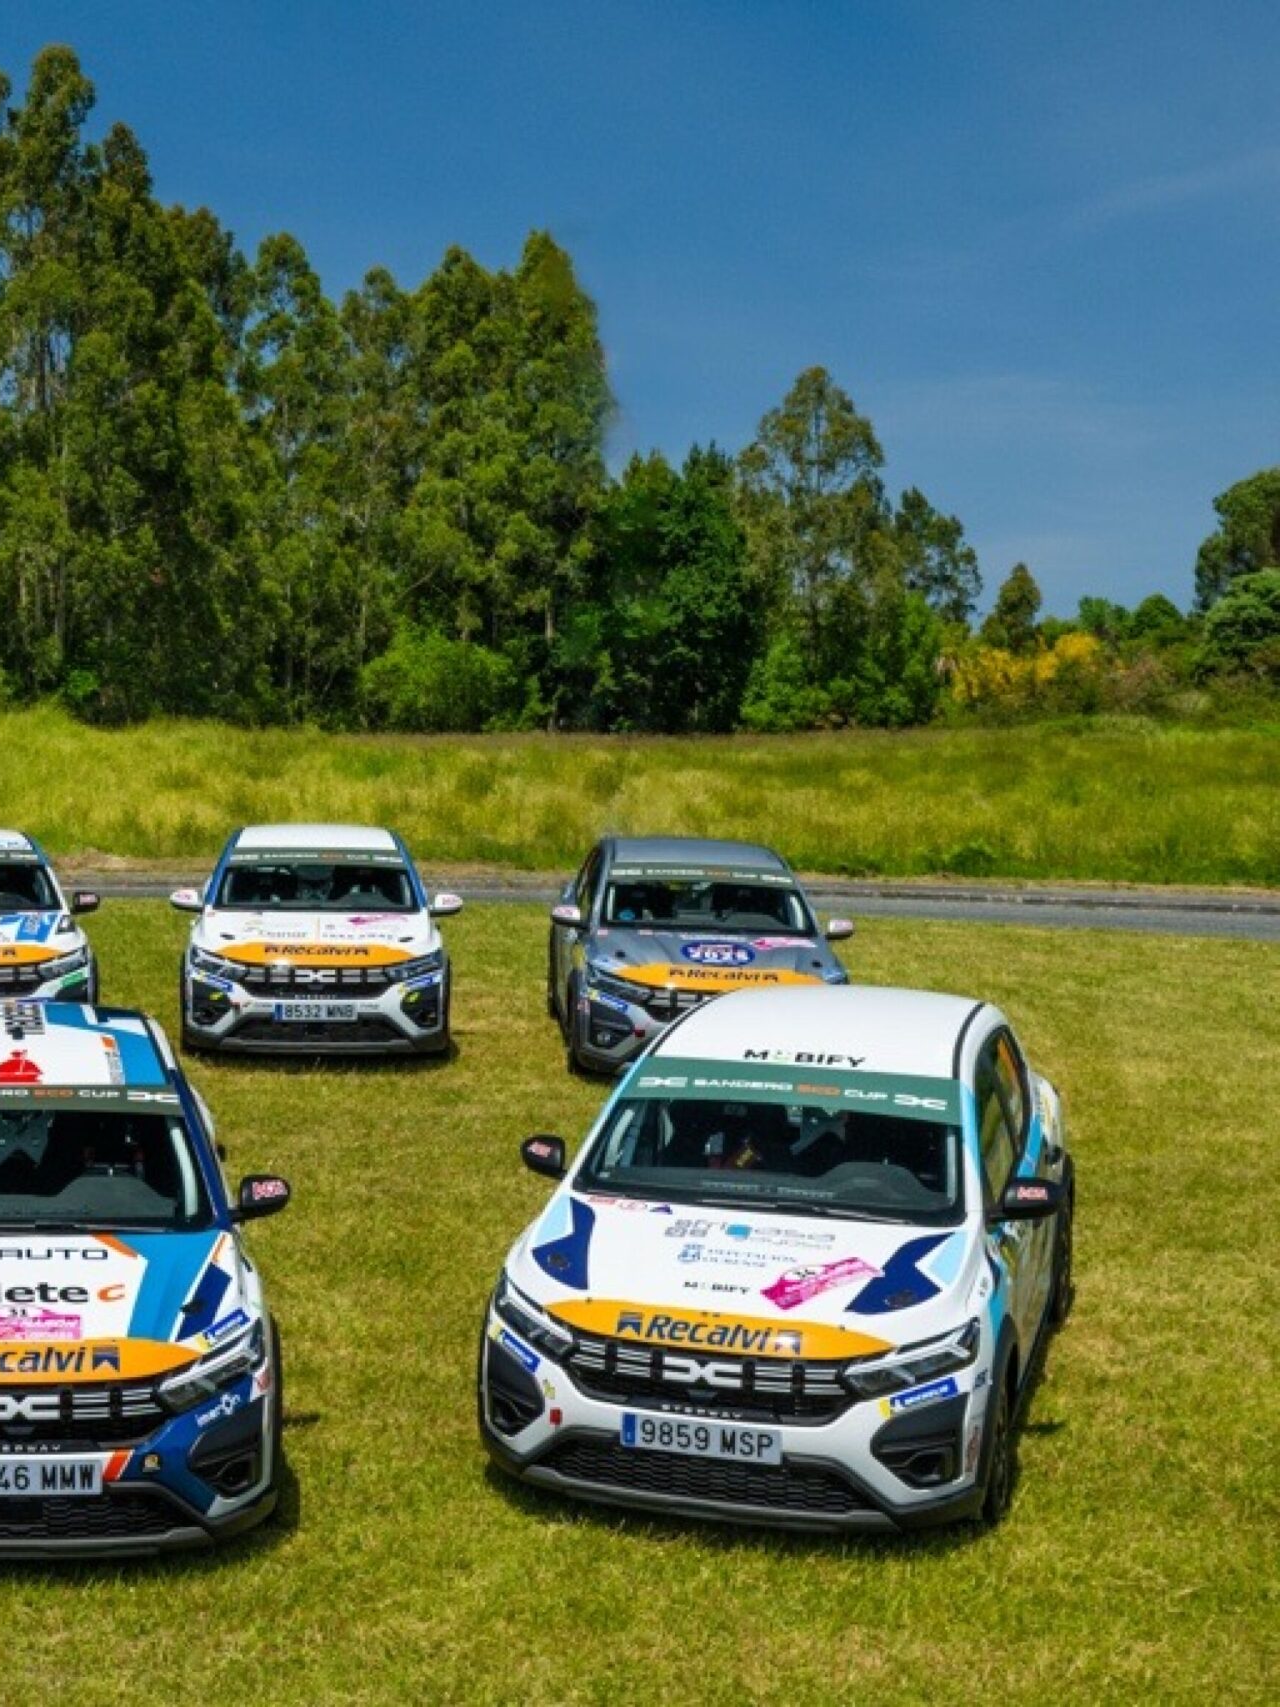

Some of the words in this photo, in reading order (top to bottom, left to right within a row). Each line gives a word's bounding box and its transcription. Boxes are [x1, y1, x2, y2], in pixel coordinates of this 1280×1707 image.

[282, 943, 353, 956] Recalvi
[687, 968, 761, 981] Recalvi
[284, 1004, 321, 1018] 8532
[326, 1004, 354, 1018] MNB
[32, 1088, 73, 1098] ECO
[79, 1088, 120, 1099] CUP
[693, 1079, 794, 1091] SANDERO
[797, 1084, 841, 1096] ECO
[844, 1089, 889, 1100] CUP
[645, 1314, 771, 1352] Recalvi
[640, 1418, 712, 1451] 9859
[719, 1429, 774, 1459] MSP
[40, 1464, 96, 1491] MMW
